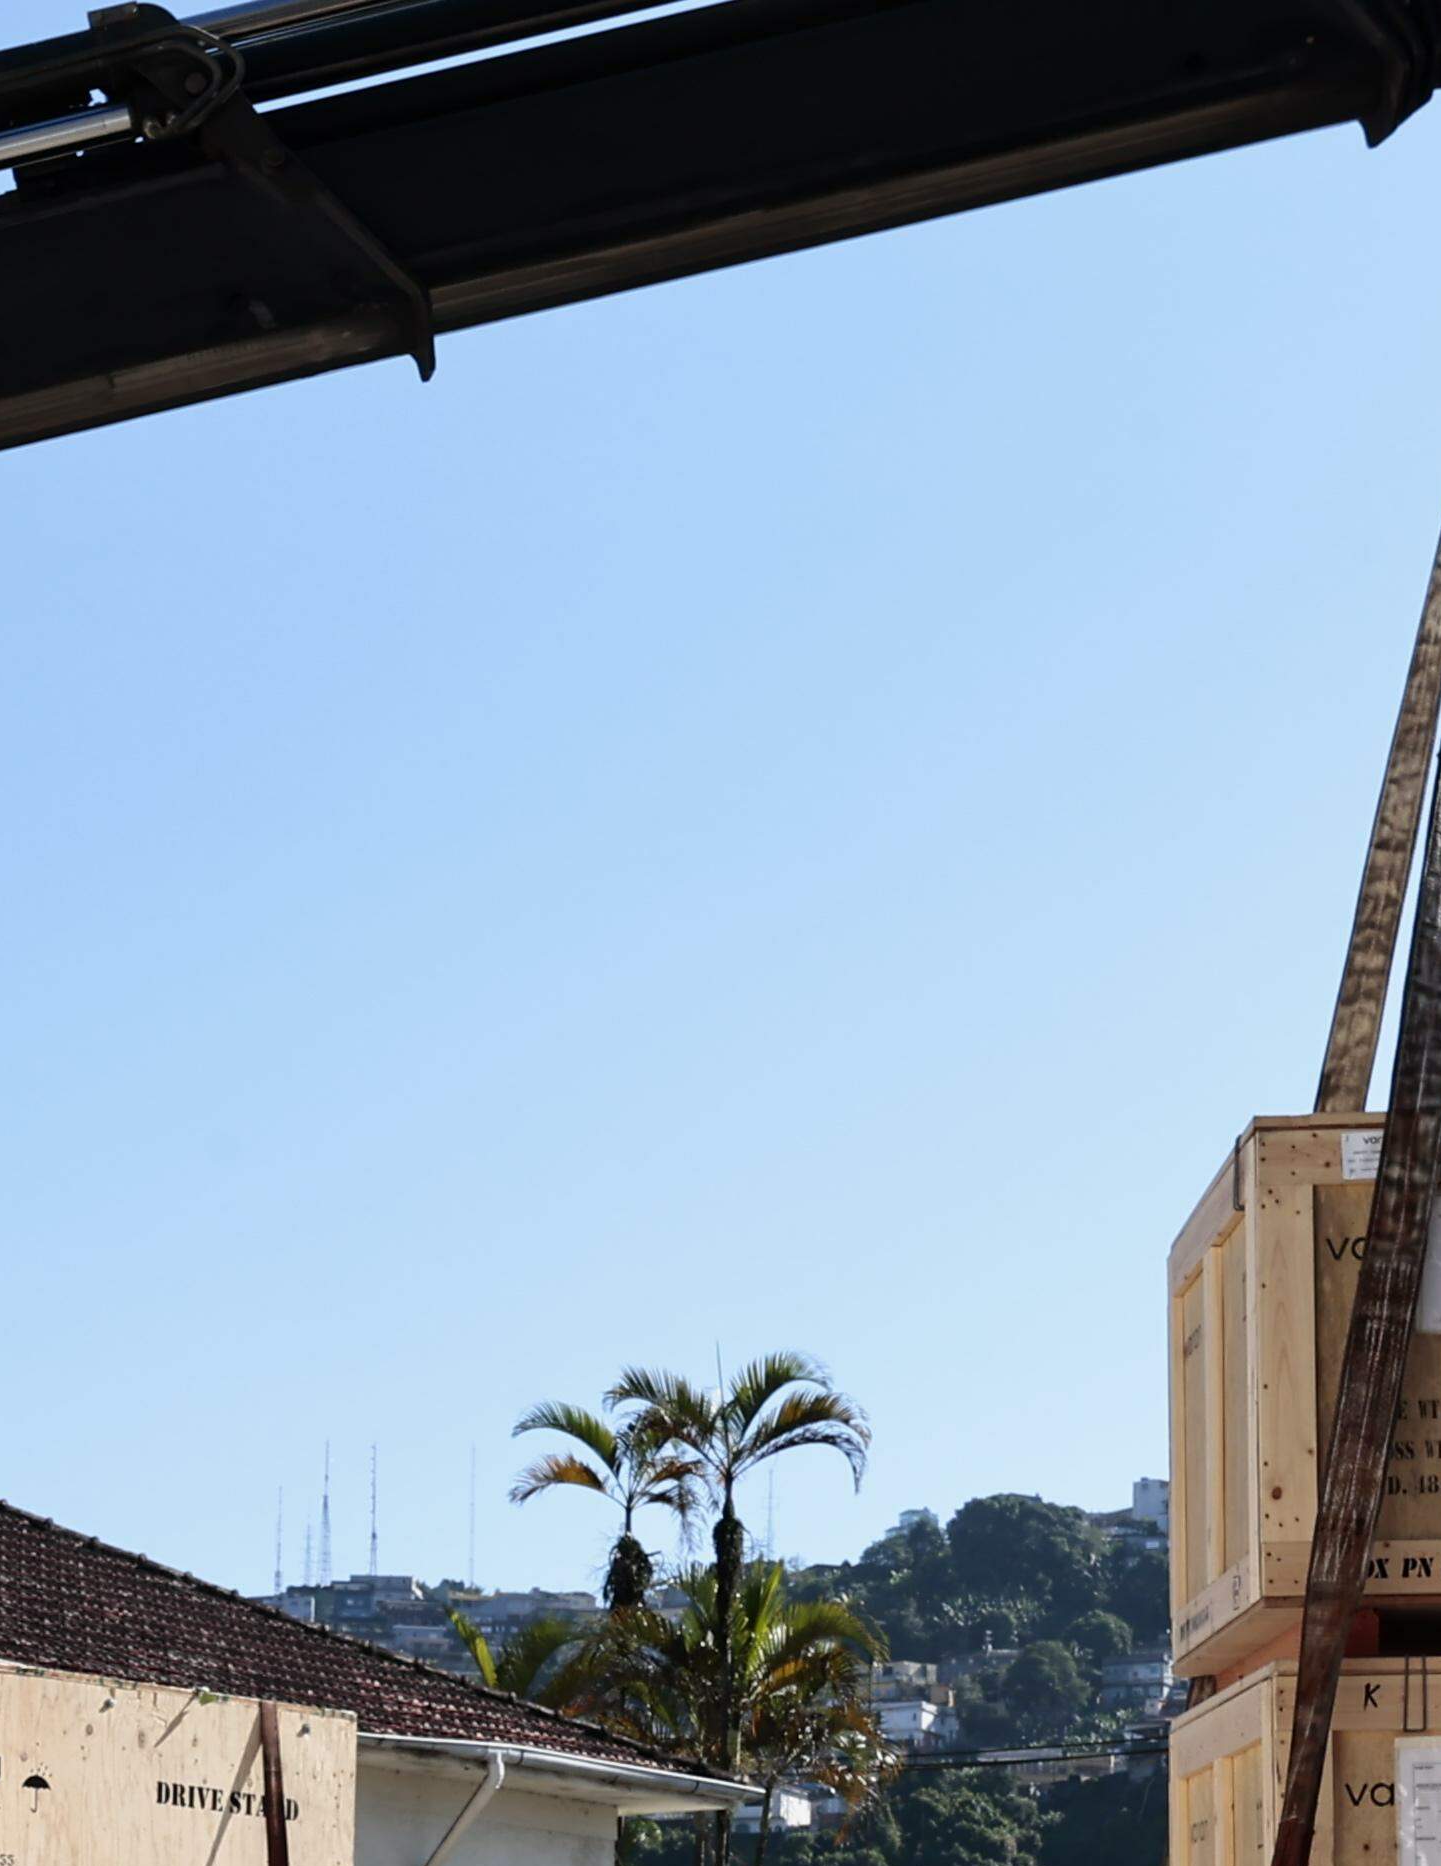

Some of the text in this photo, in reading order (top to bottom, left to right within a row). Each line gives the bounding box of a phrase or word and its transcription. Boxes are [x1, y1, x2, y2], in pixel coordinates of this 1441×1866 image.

[1402, 1557, 1434, 1579] PN
[1363, 1682, 1382, 1711] K
[156, 1780, 300, 1822] DRIVE STAD
